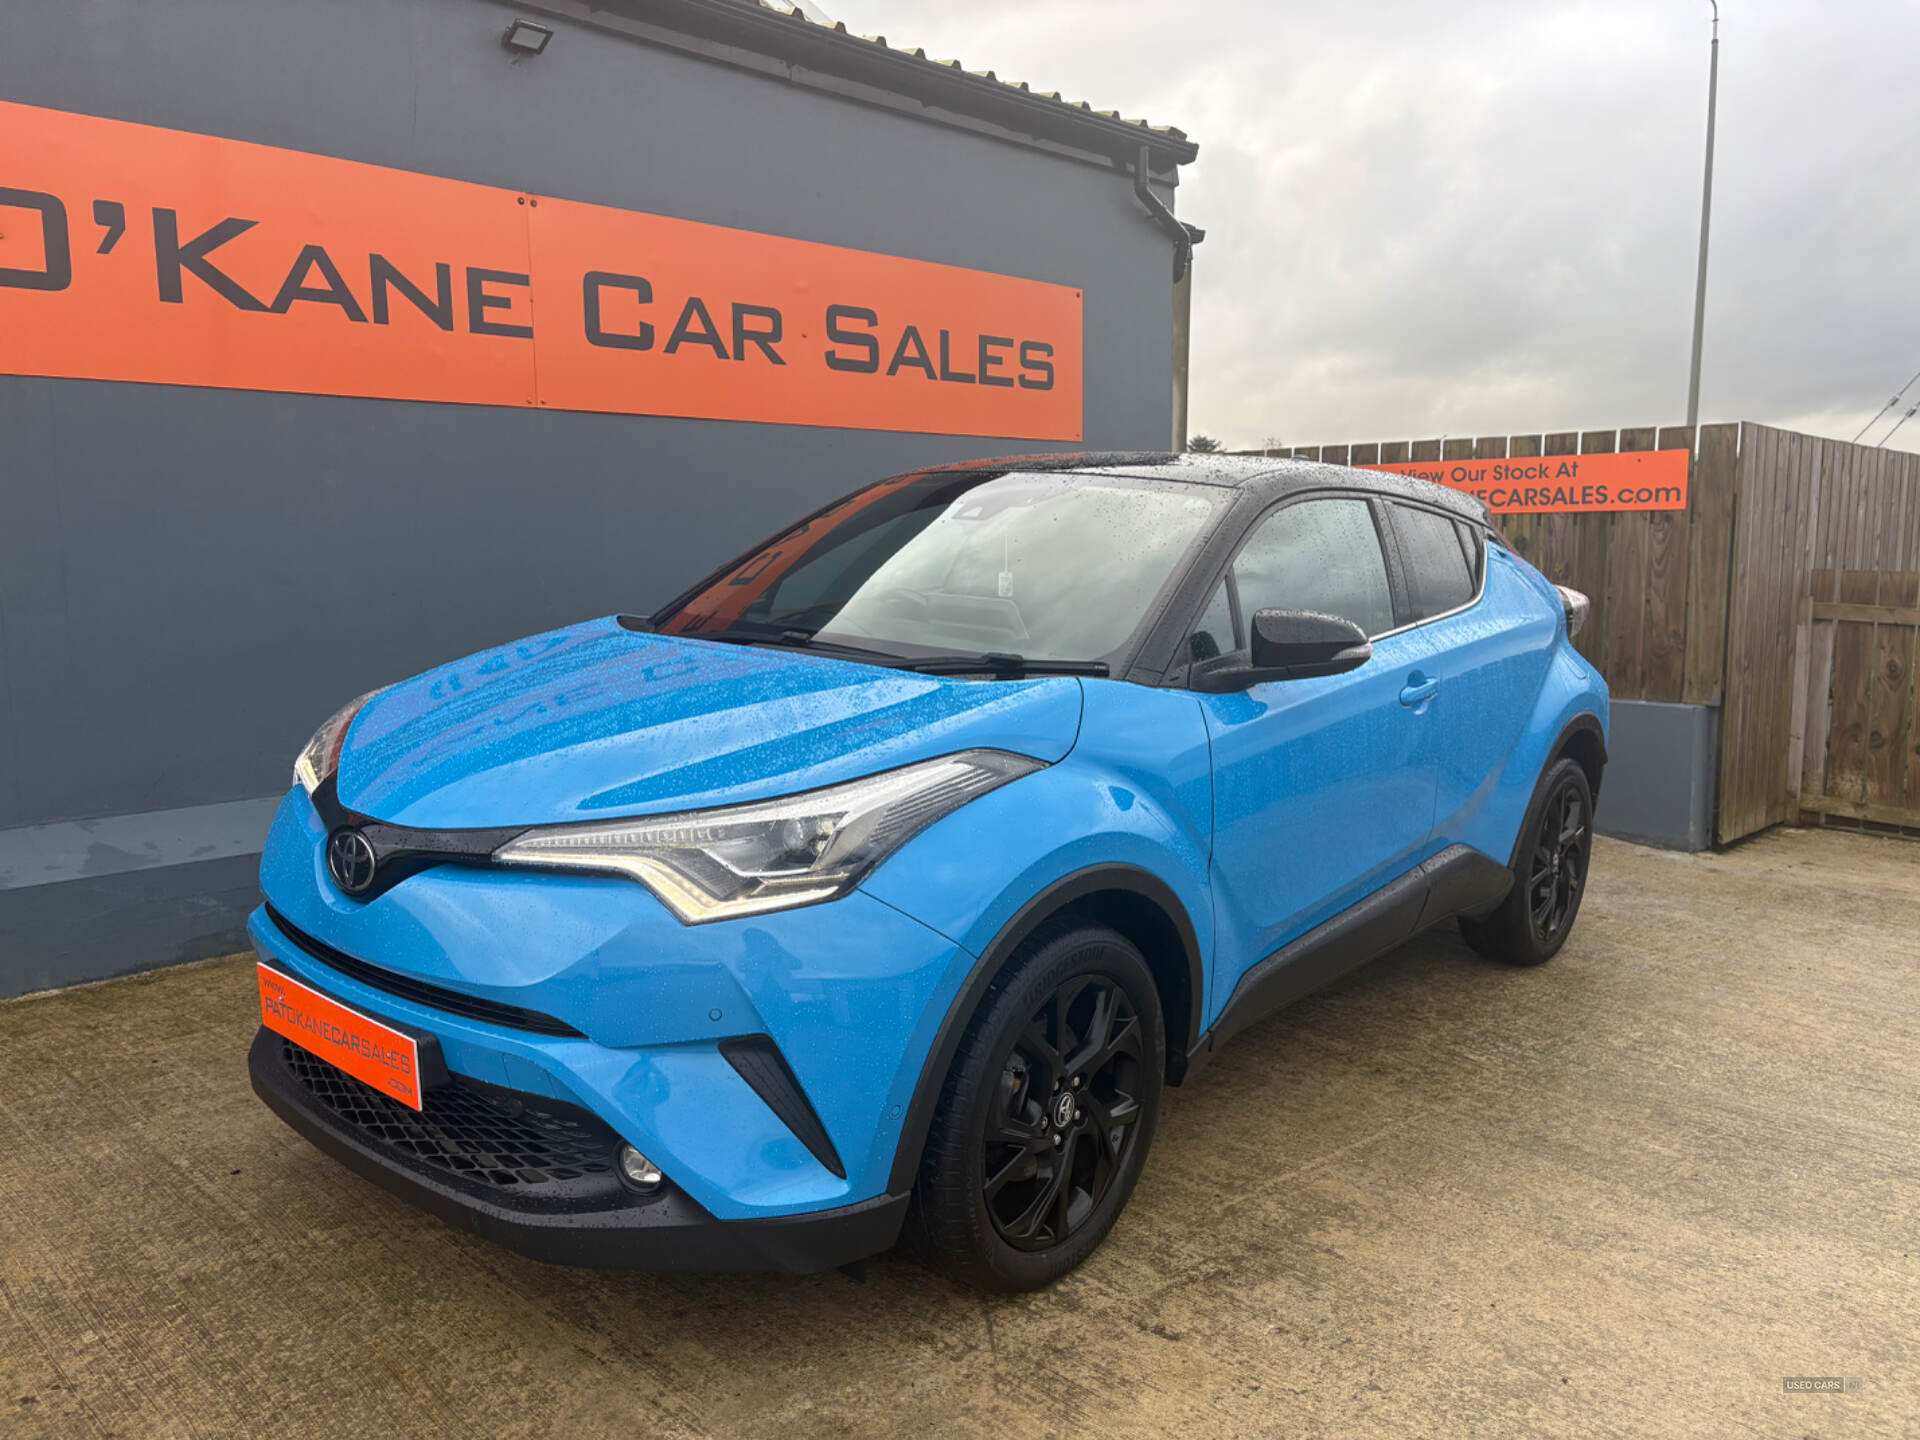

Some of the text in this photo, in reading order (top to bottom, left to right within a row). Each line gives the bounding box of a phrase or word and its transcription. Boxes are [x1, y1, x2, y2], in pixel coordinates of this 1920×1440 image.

[583, 270, 787, 366] CAR
[824, 304, 1055, 391] SALES
[1451, 466, 1487, 482] Our
[1492, 461, 1550, 481] Stock
[1555, 461, 1579, 478] At
[1470, 485, 1682, 508] ECARSALES.com
[265, 996, 411, 1076] PATOKANECARSALES
